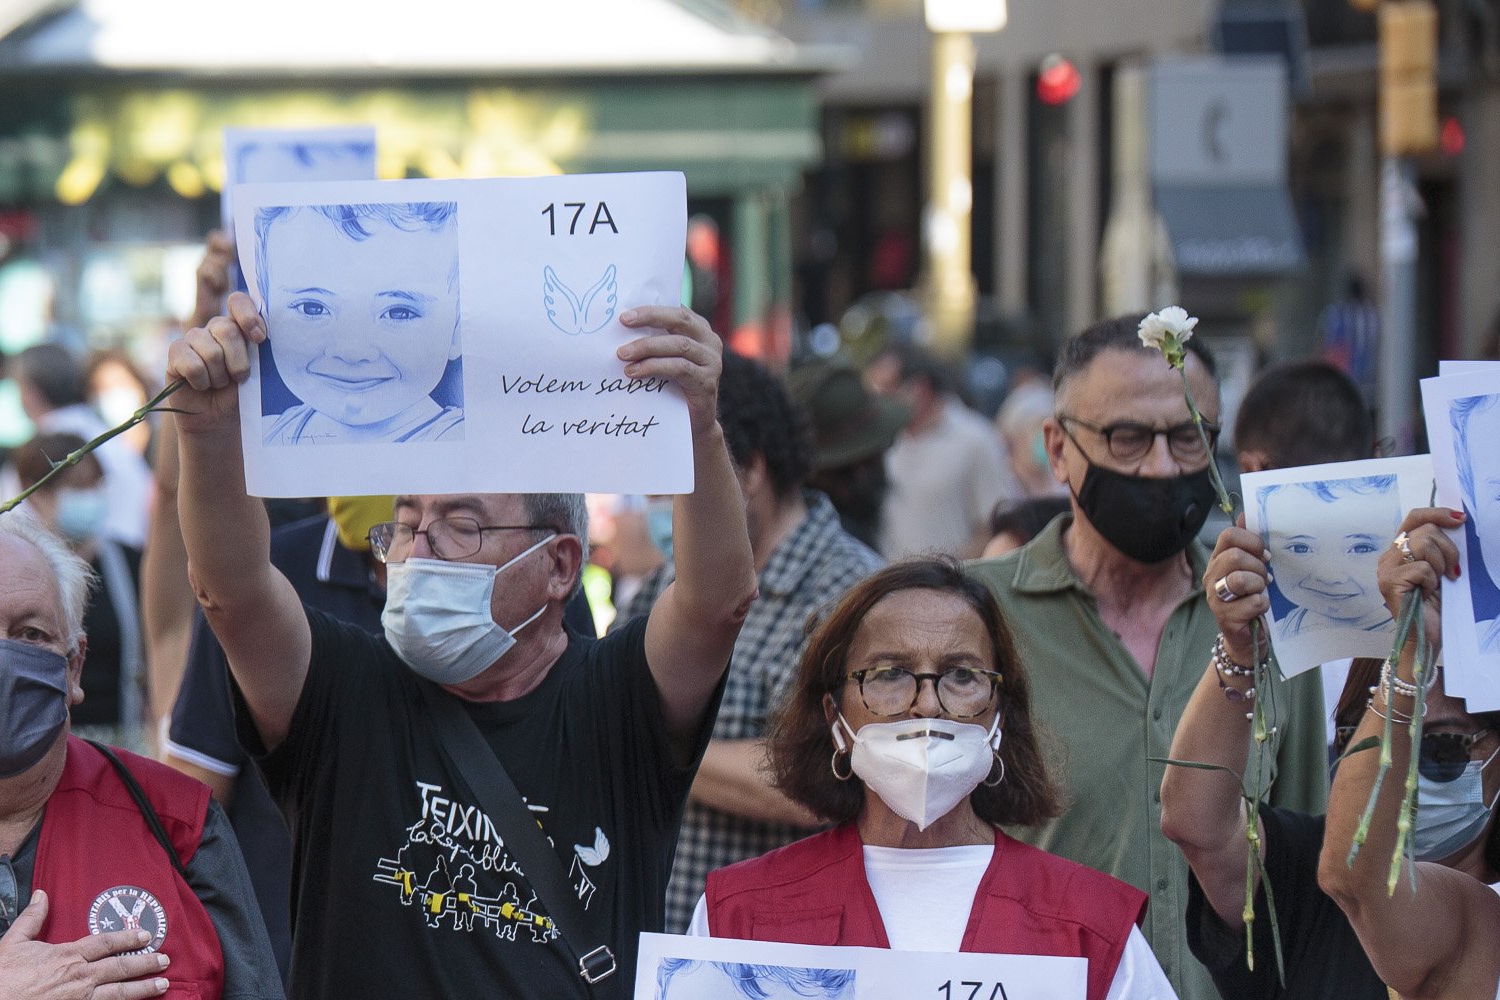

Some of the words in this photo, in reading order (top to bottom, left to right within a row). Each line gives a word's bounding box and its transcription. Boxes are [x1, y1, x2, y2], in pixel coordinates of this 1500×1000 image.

[541, 201, 619, 235] 17A
[501, 373, 591, 394] Volem
[521, 414, 554, 434] la
[563, 414, 660, 437] veritat
[416, 780, 504, 848] TEIXIN
[89, 891, 111, 936] OLUNTARIS
